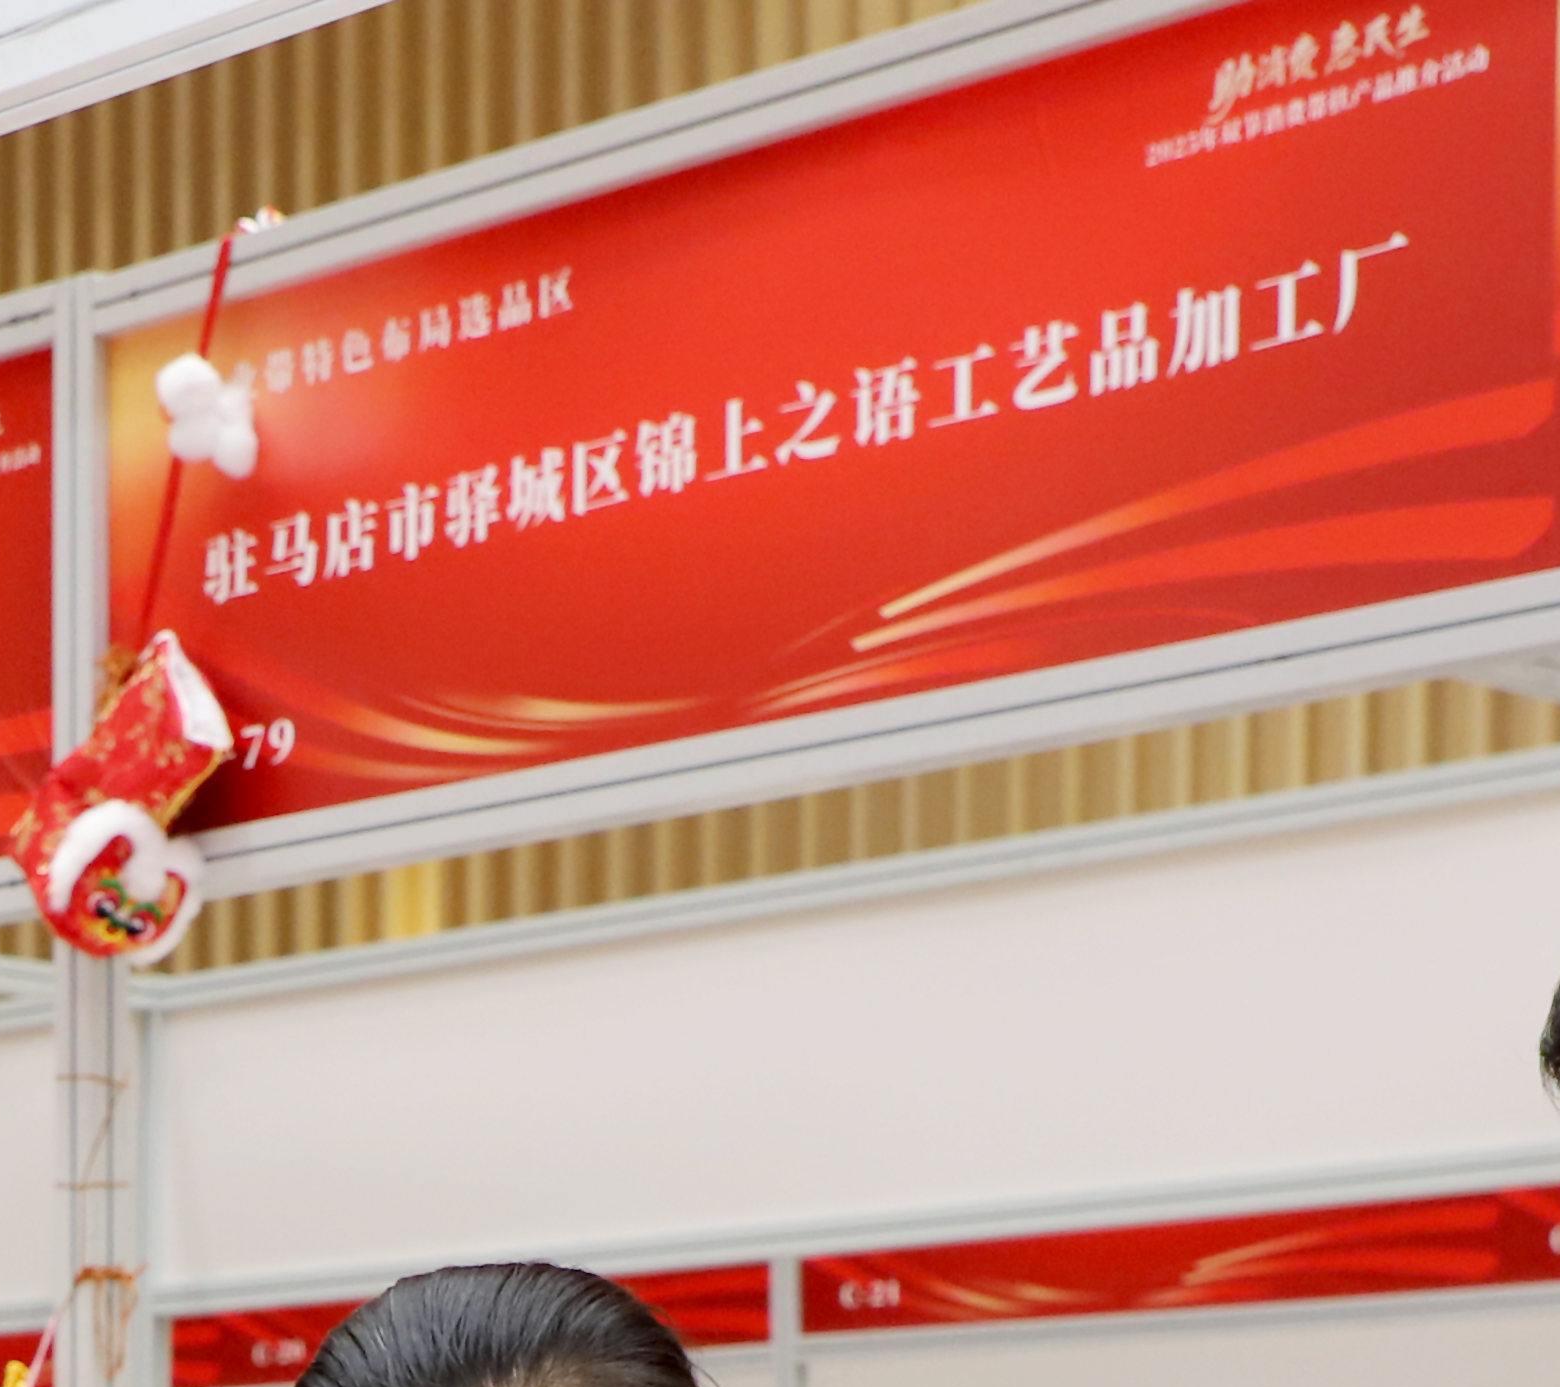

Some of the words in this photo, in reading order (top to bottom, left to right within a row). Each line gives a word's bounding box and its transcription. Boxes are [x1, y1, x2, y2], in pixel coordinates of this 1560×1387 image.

[202, 231, 1408, 604] 驻马店市驿城区锦上之语工艺品加工厂
